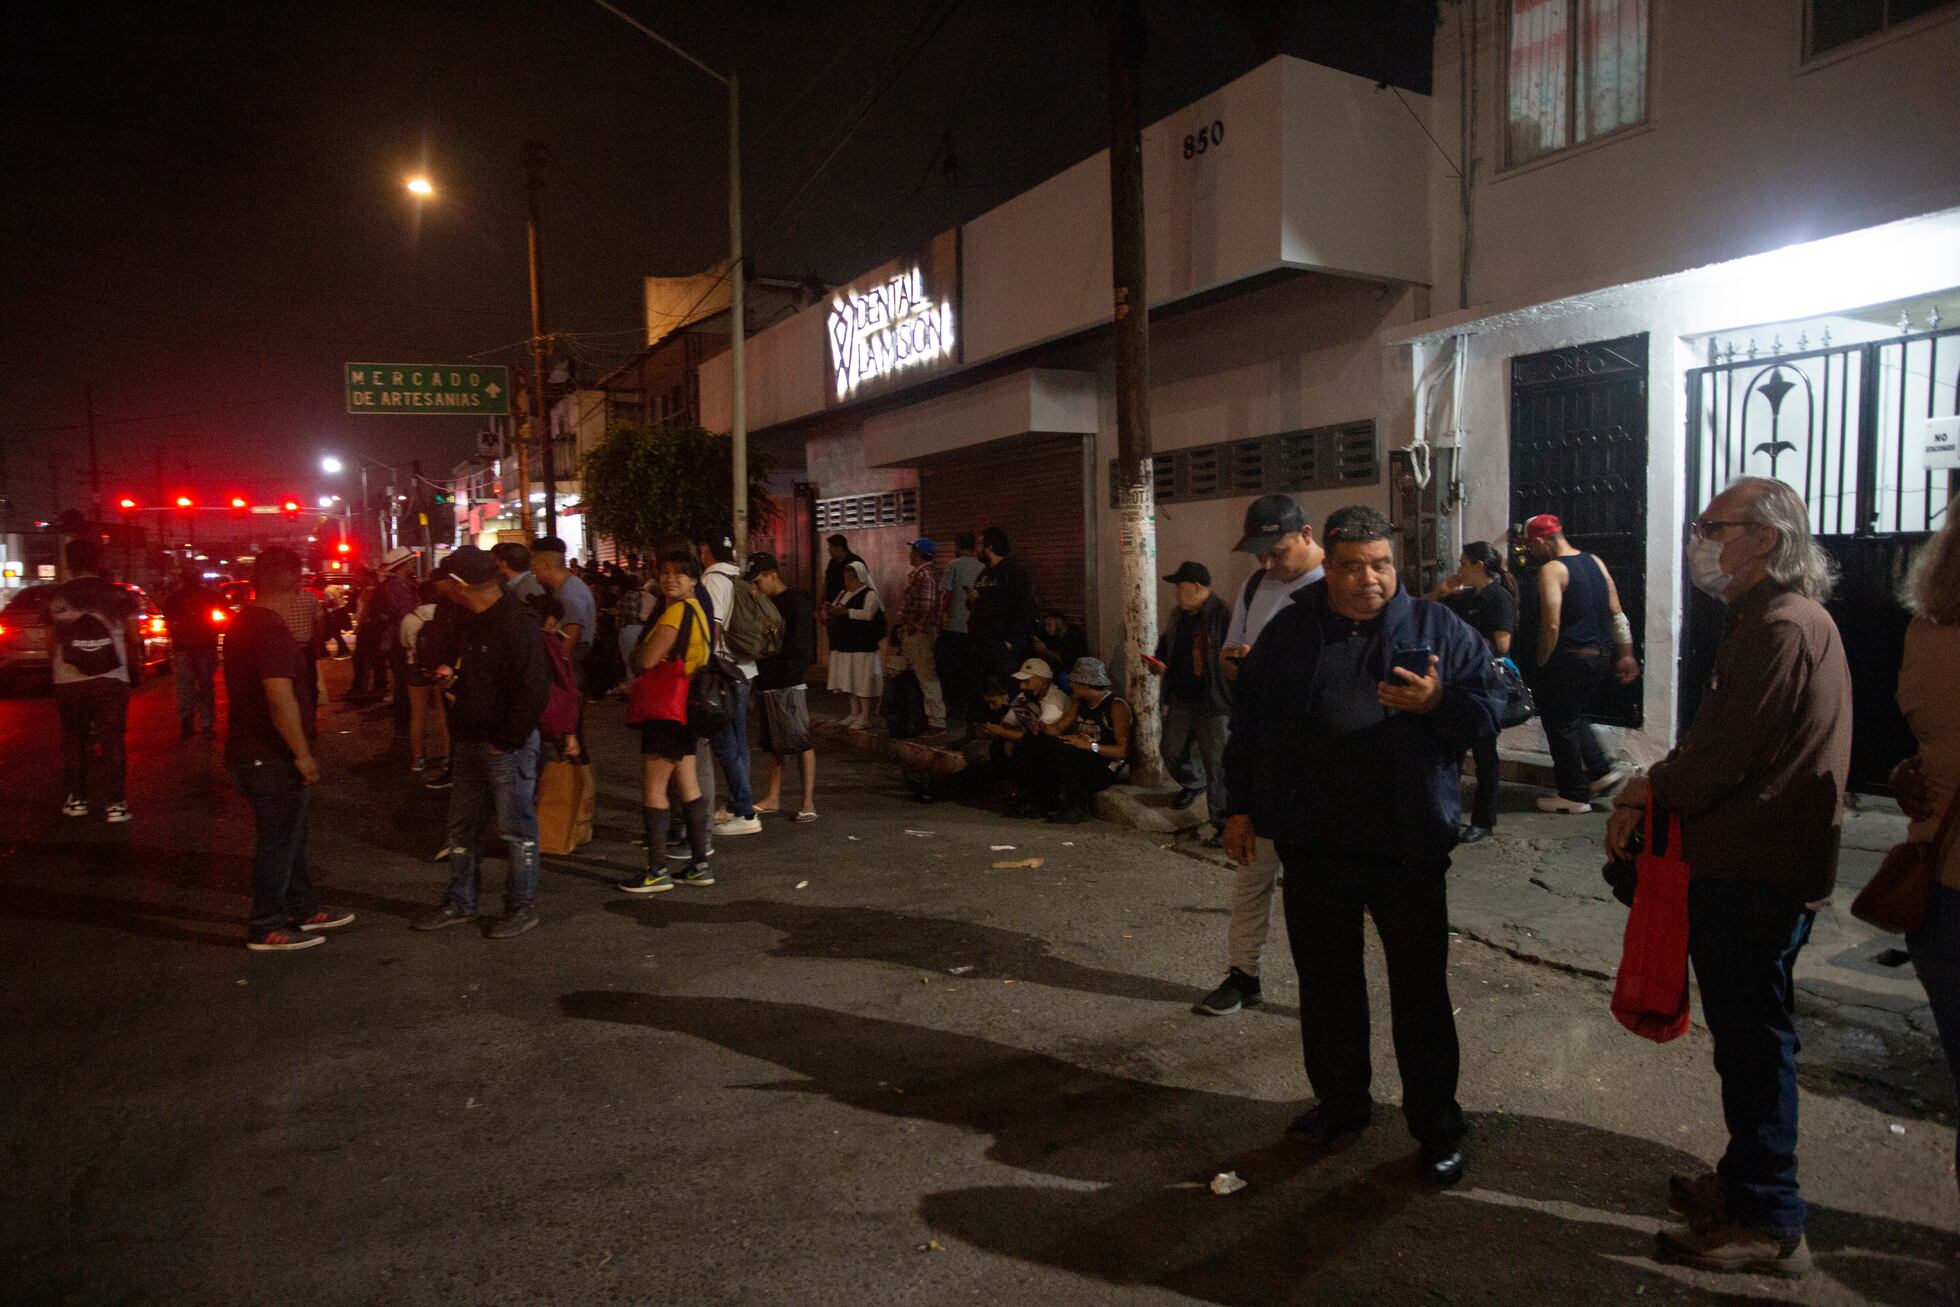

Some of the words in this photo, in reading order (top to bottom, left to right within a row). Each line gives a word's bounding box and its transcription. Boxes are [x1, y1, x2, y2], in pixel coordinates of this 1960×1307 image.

[1183, 120, 1224, 160] 850
[857, 272, 922, 331] DENTAL
[351, 370, 481, 387] MERCADO
[353, 391, 375, 405] DE
[380, 391, 480, 406] ARTESANIAS
[1934, 433, 1948, 442] NO
